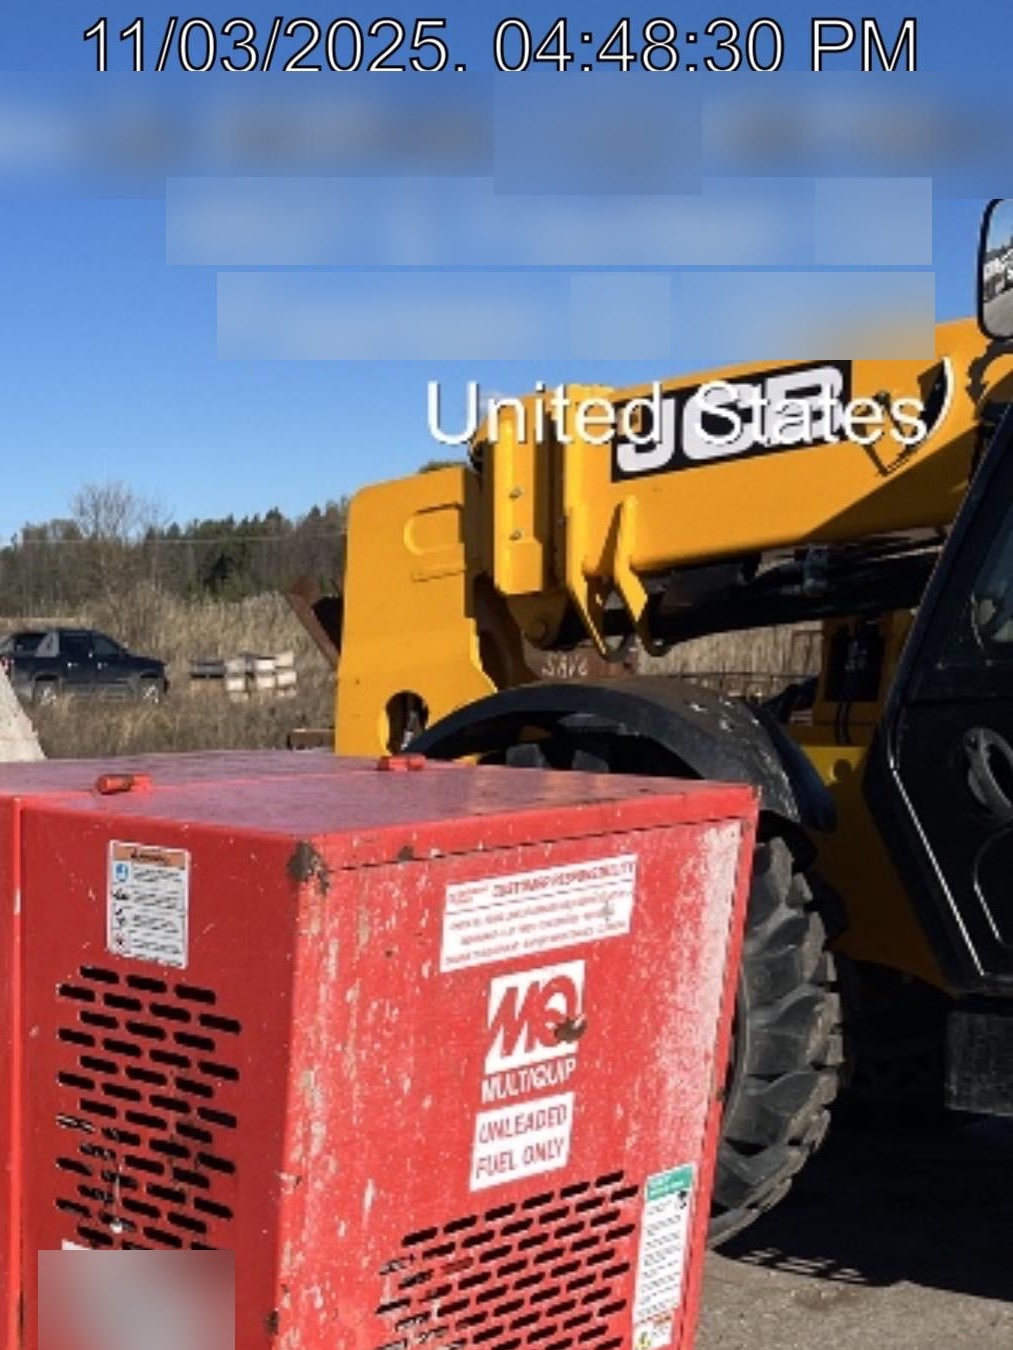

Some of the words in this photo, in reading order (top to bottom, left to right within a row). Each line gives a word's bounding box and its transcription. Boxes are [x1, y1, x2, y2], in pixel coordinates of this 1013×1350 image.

[617, 366, 845, 472] JCB
[488, 973, 582, 1062] MQ
[482, 1058, 577, 1104] MULTIQUIP
[478, 1104, 568, 1144] UNLEADED
[475, 1149, 516, 1180] FUEL
[522, 1137, 565, 1170] ONLY
